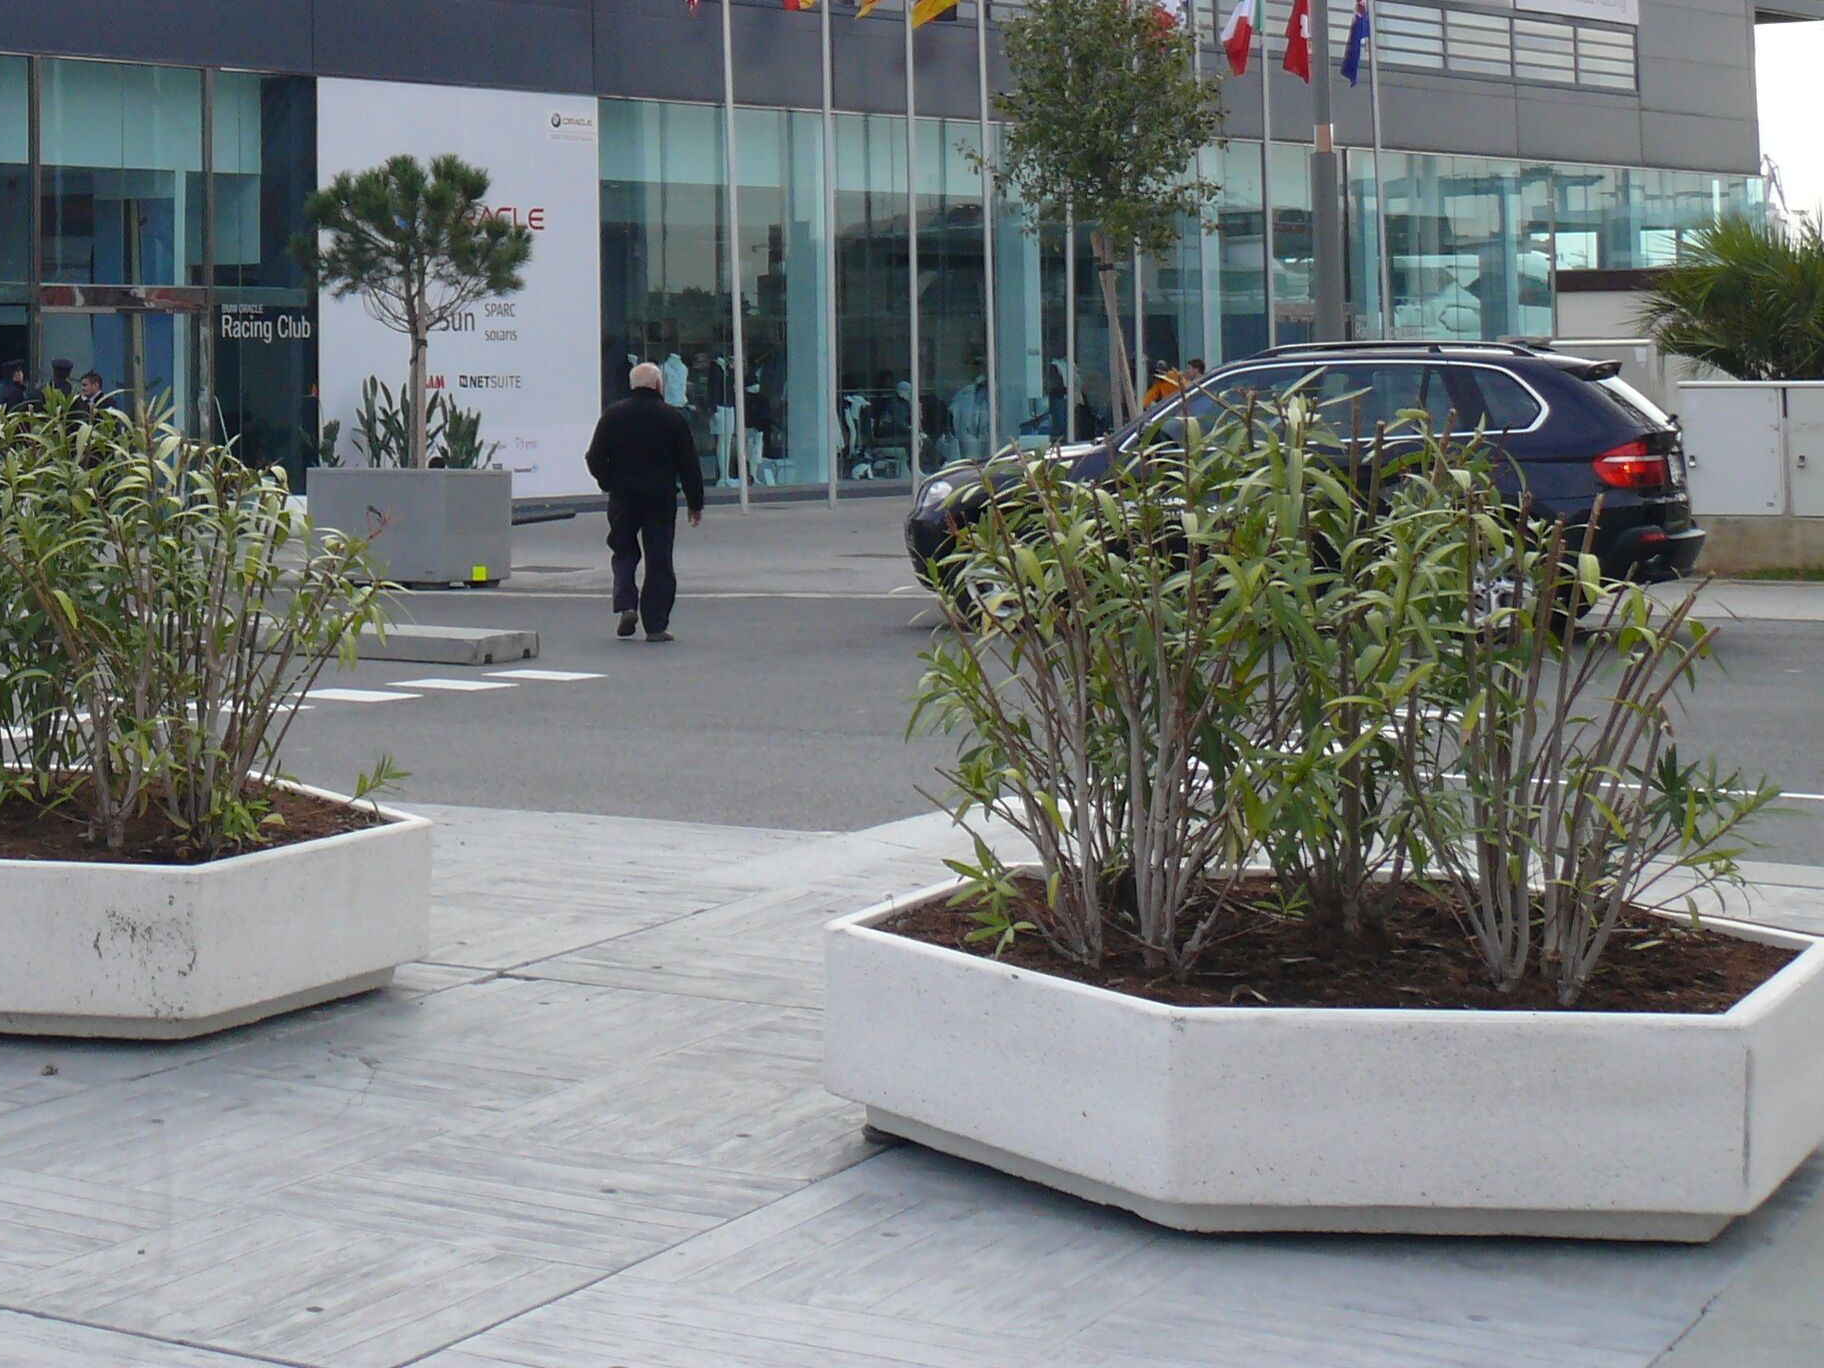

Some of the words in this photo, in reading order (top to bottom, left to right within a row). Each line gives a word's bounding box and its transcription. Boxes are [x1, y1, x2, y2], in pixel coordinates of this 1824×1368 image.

[484, 302, 516, 318] SPARC
[221, 314, 272, 344] Racing
[277, 314, 311, 338] Club
[469, 375, 522, 389] NETSUITE
